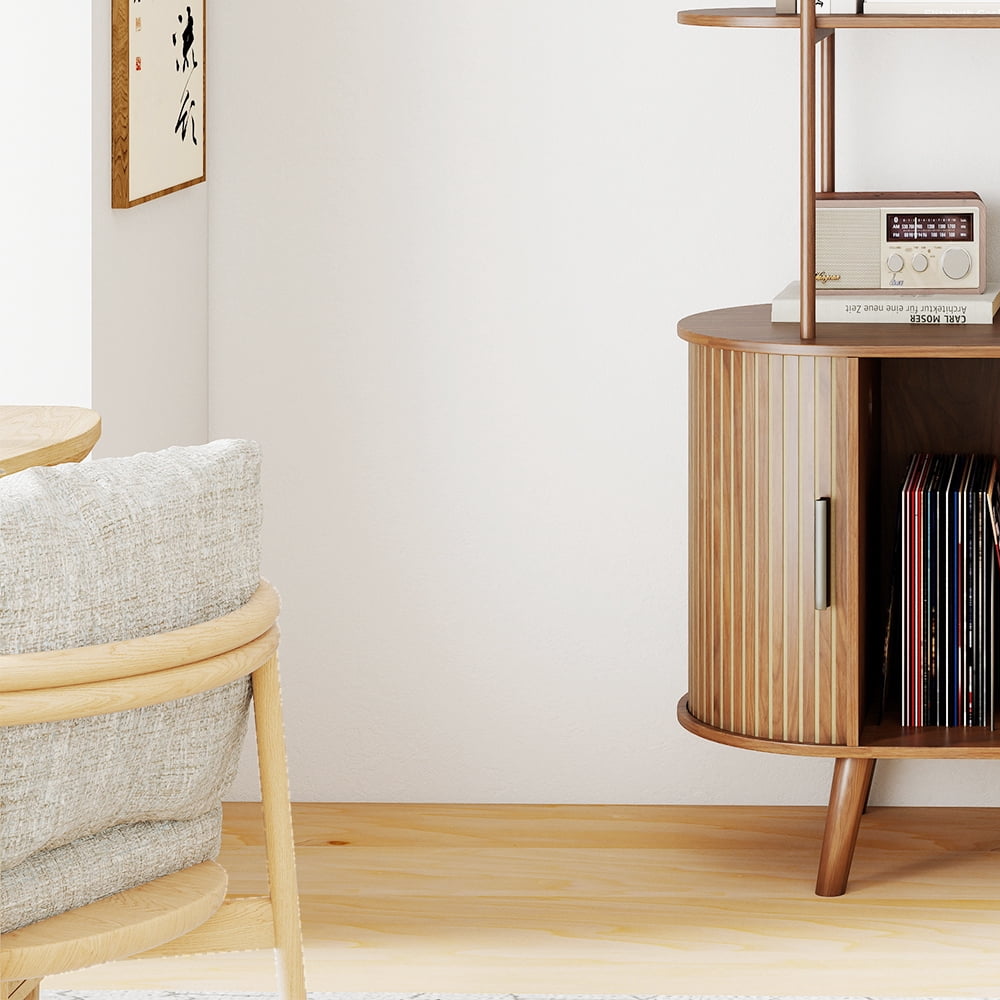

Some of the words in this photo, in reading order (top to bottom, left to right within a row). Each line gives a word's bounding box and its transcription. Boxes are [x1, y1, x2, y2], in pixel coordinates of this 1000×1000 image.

[845, 304, 861, 313] Zeit
[864, 305, 884, 313] neue
[886, 305, 904, 313] eine
[905, 305, 918, 314] für
[920, 305, 967, 314] Architektur
[910, 314, 941, 323] MOSER
[944, 314, 967, 324] CARL
